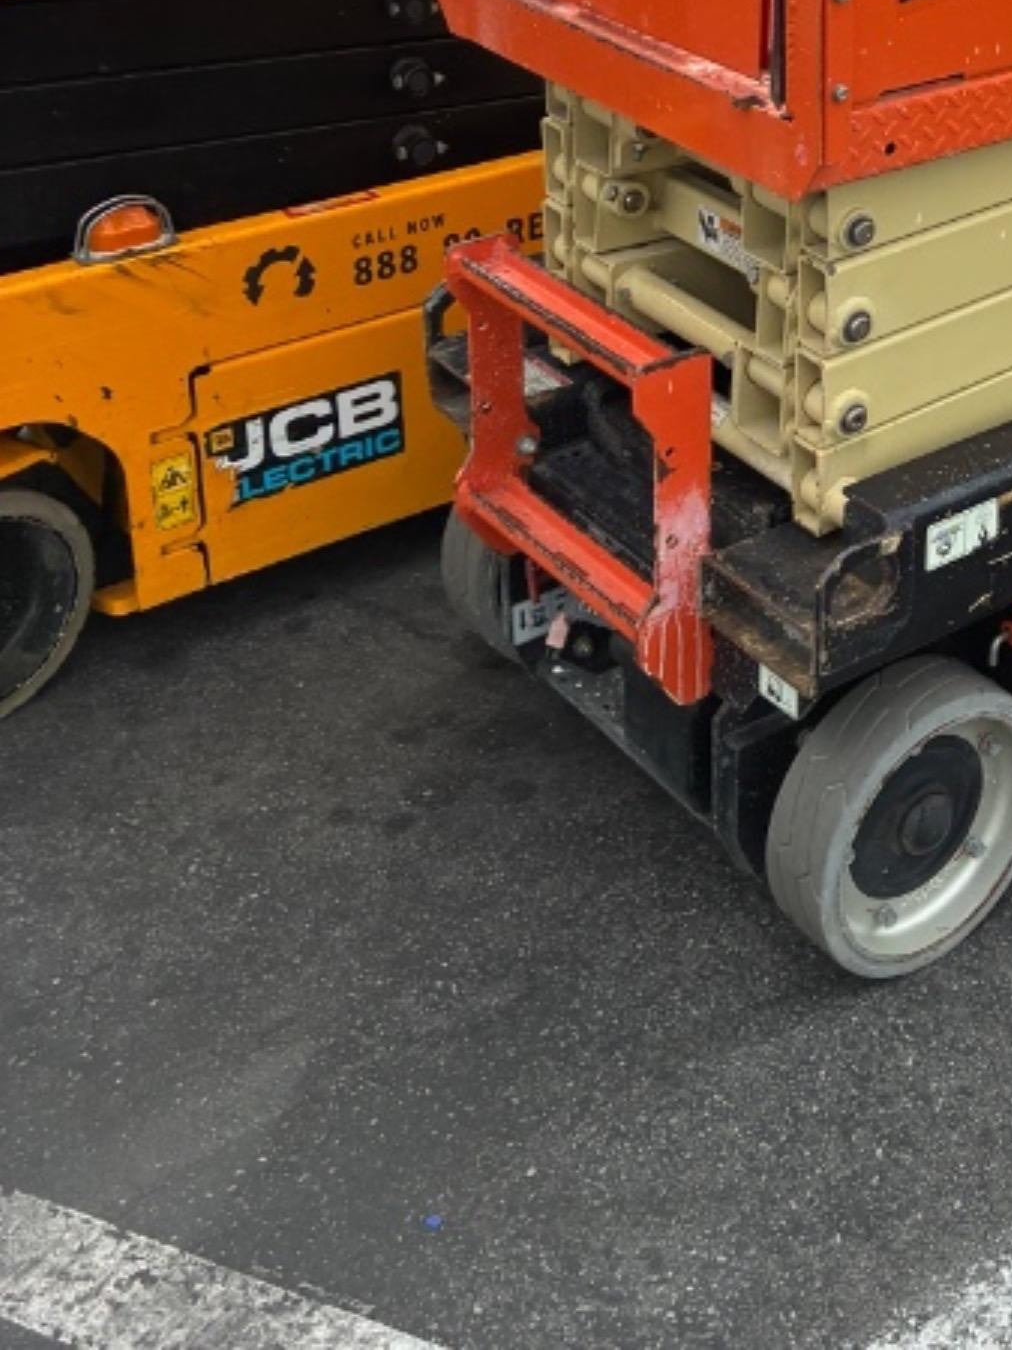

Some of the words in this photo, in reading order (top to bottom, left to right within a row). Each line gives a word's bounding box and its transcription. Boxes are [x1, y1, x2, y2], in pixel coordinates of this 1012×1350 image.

[351, 225, 397, 250] CALL
[406, 211, 446, 236] NOW
[353, 244, 419, 287] 888
[215, 379, 400, 473] JCB
